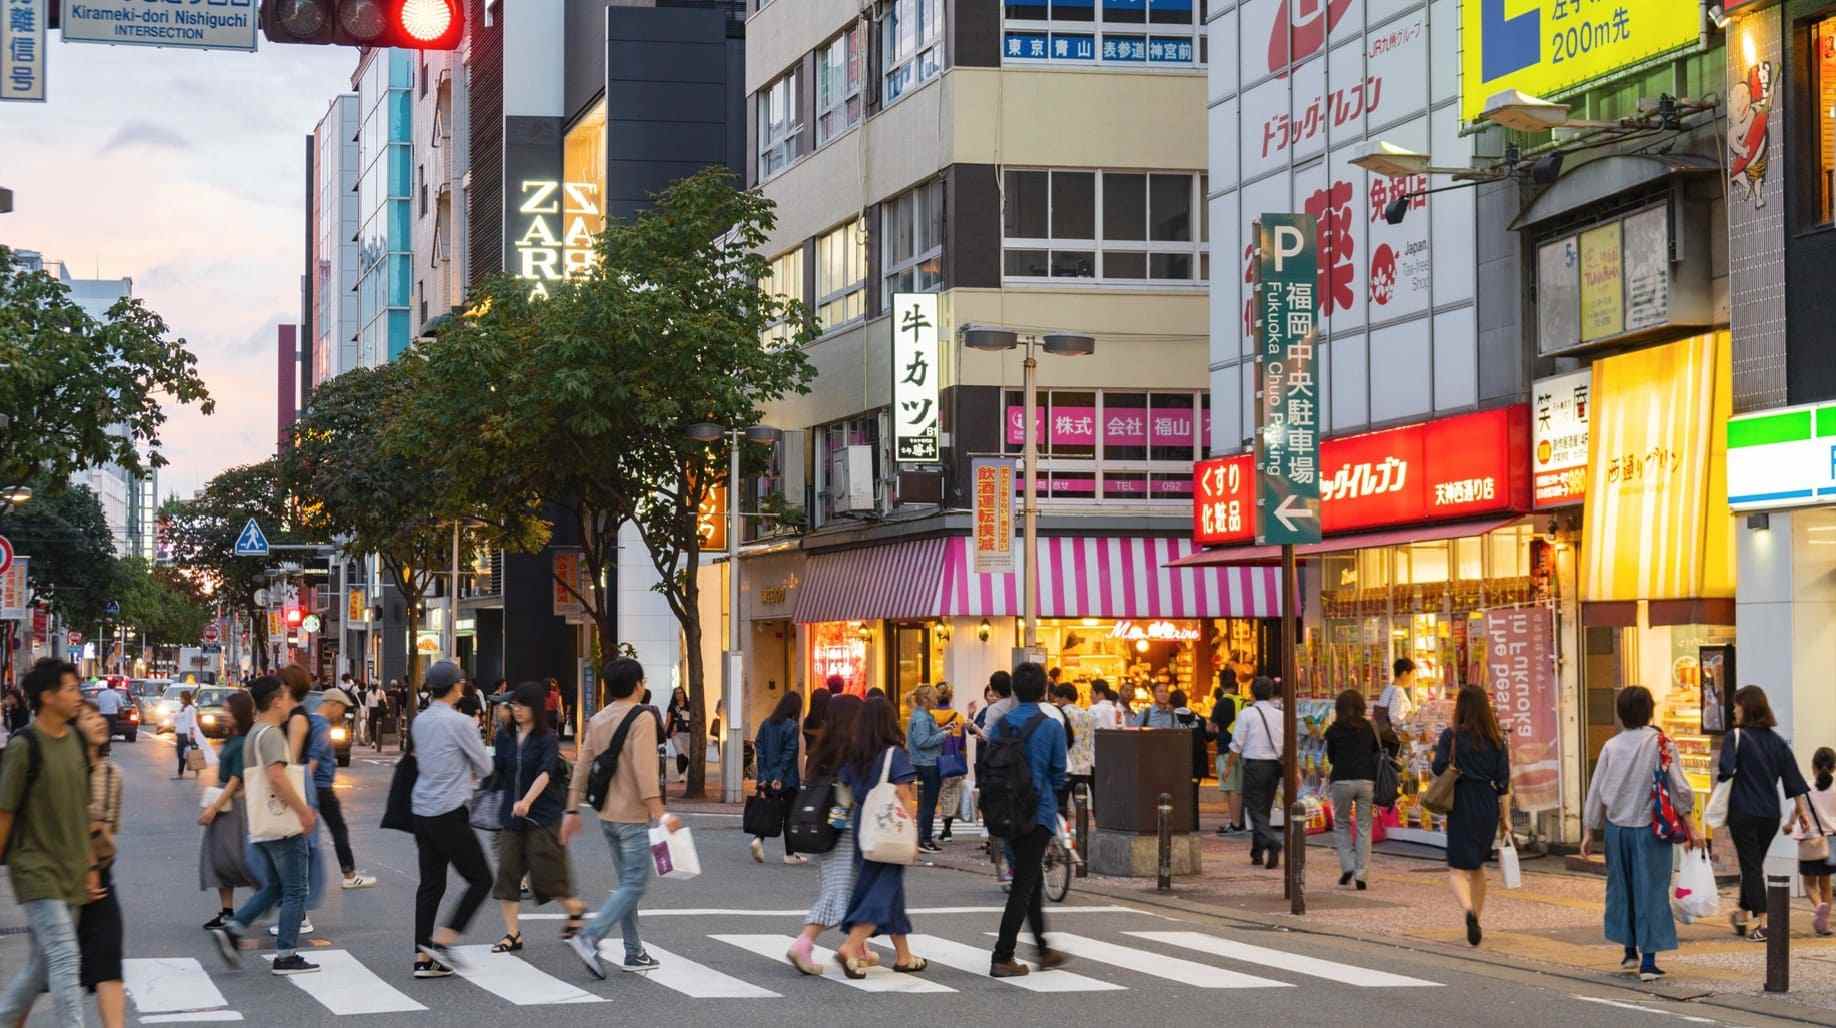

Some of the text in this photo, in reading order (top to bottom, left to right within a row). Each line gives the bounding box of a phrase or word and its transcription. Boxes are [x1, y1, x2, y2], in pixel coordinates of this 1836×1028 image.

[71, 4, 248, 29] Kirameki-dori Nishiguchi
[114, 24, 204, 40] INTERSECTION
[1552, 6, 1630, 65] 200m先
[9, 0, 36, 92] 離信号
[1261, 75, 1382, 159] ドラッグイレブン
[515, 180, 562, 304] ZARA
[1275, 225, 1305, 272] P
[901, 303, 932, 425] 牛カツ
[1266, 282, 1284, 476] Fukuoka Chuo Pking
[1286, 283, 1315, 485] 福岡中央駐車場
[1115, 481, 1135, 491] TEL
[1162, 481, 1181, 492] 092
[1201, 463, 1240, 496] くすり
[1319, 456, 1408, 502] ッグイレブン
[1434, 477, 1495, 506] 天神西通り店
[1201, 499, 1242, 536] 化粧品
